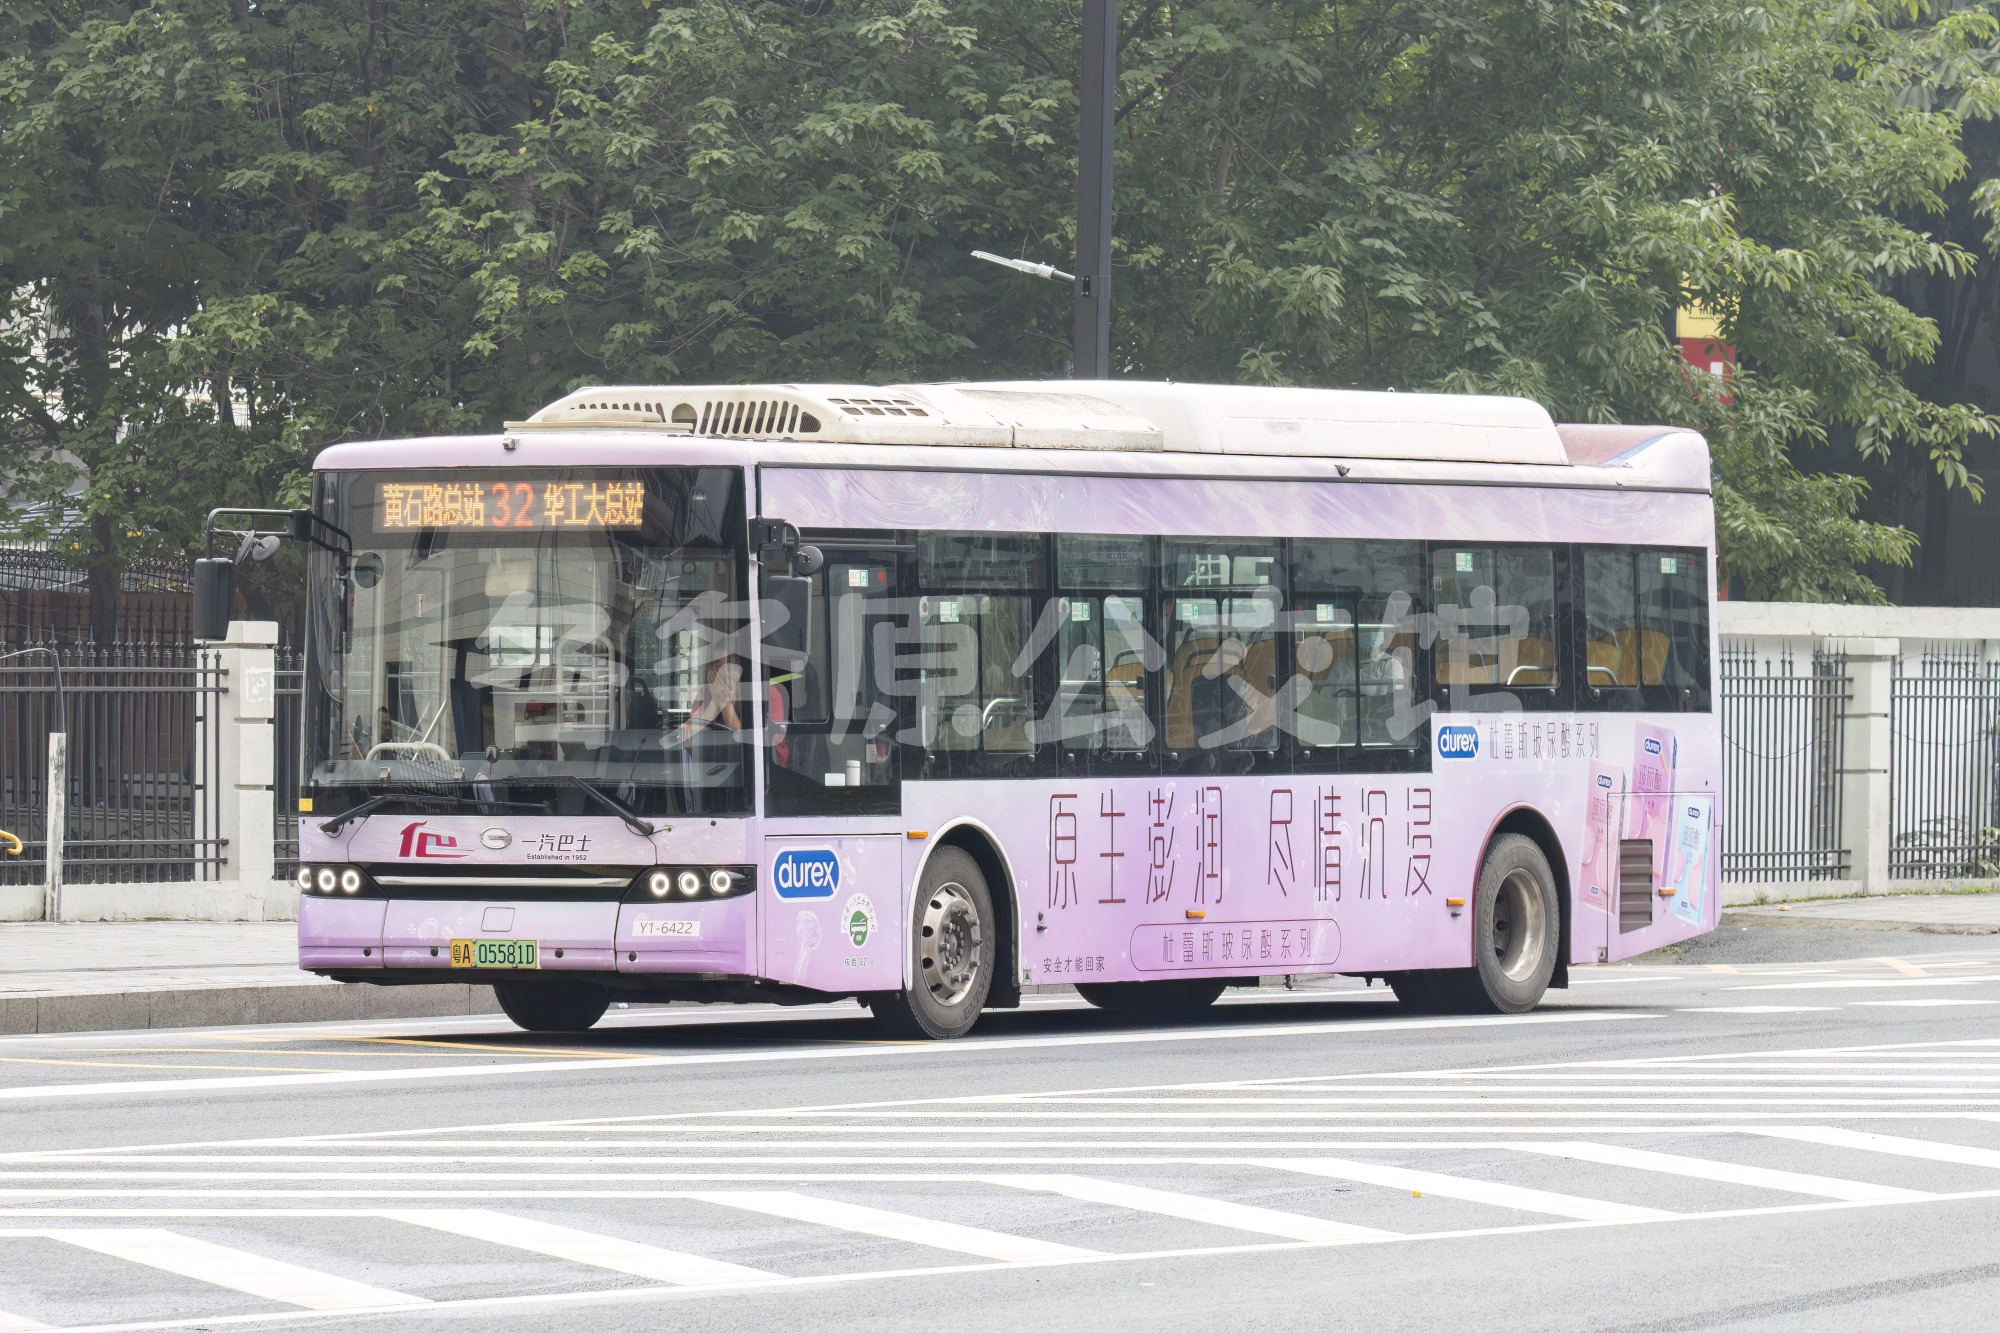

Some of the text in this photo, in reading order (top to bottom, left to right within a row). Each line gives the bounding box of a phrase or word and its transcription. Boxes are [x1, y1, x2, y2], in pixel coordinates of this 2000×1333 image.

[383, 482, 644, 527] 黄石路总站 32 华工大总站
[1440, 728, 1477, 756] durex
[1489, 721, 1600, 759] 杜蕾斯玻尿酸系列
[1645, 740, 1660, 754] durex
[1598, 775, 1612, 789] durex
[1639, 764, 1662, 790] 玻尿酸
[522, 833, 592, 852] 一汽巴士
[1048, 785, 1432, 909] 原生澎润 尽情沉浸
[572, 853, 587, 861] 1952
[778, 854, 836, 893] durex
[640, 922, 693, 935] Y1-6422
[1162, 927, 1311, 963] 杜蕾斯玻尿酸系列
[1043, 955, 1105, 974] 安全才能回家
